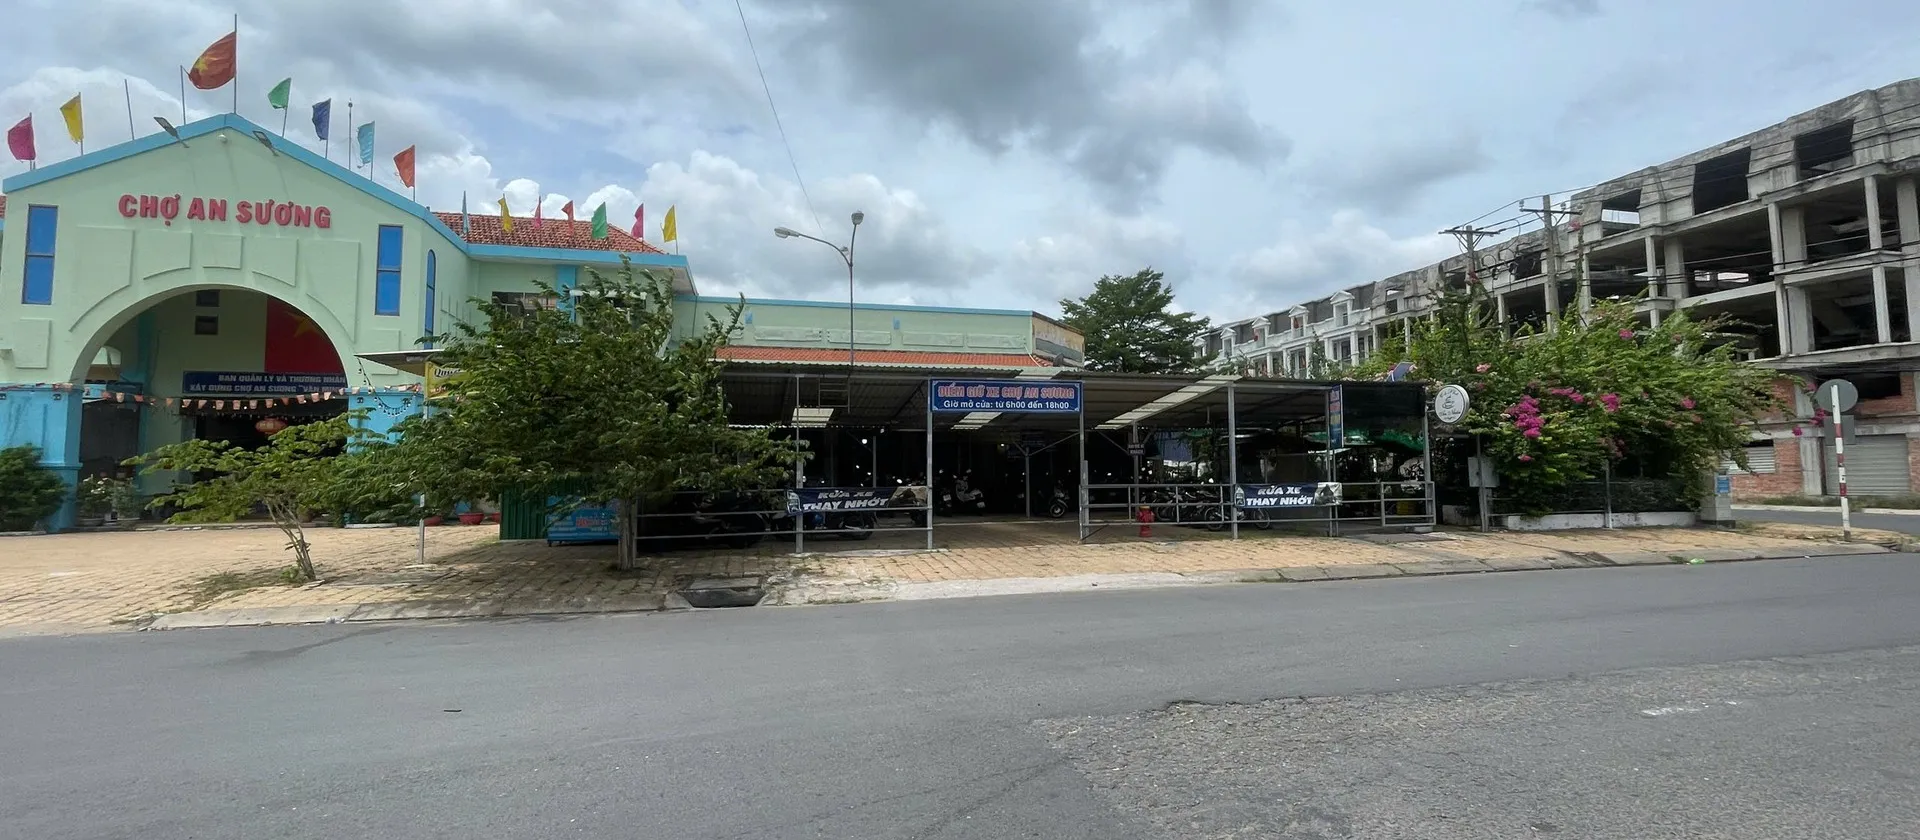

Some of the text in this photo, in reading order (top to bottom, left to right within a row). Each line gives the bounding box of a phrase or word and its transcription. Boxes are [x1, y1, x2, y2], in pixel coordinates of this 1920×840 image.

[118, 193, 331, 228] CHỢ AN SƯƠNG
[218, 374, 237, 382] BAN
[938, 381, 1075, 400] ĐIỂM GIỮ XE CHỢ AN SƯƠNG
[943, 399, 1070, 409] Giờ mở cửa: từ 6h00 đến 18h00
[1286, 486, 1302, 495] XE
[802, 497, 888, 511] THAY NHỚT
[1246, 494, 1313, 506] THAY NHỚT
